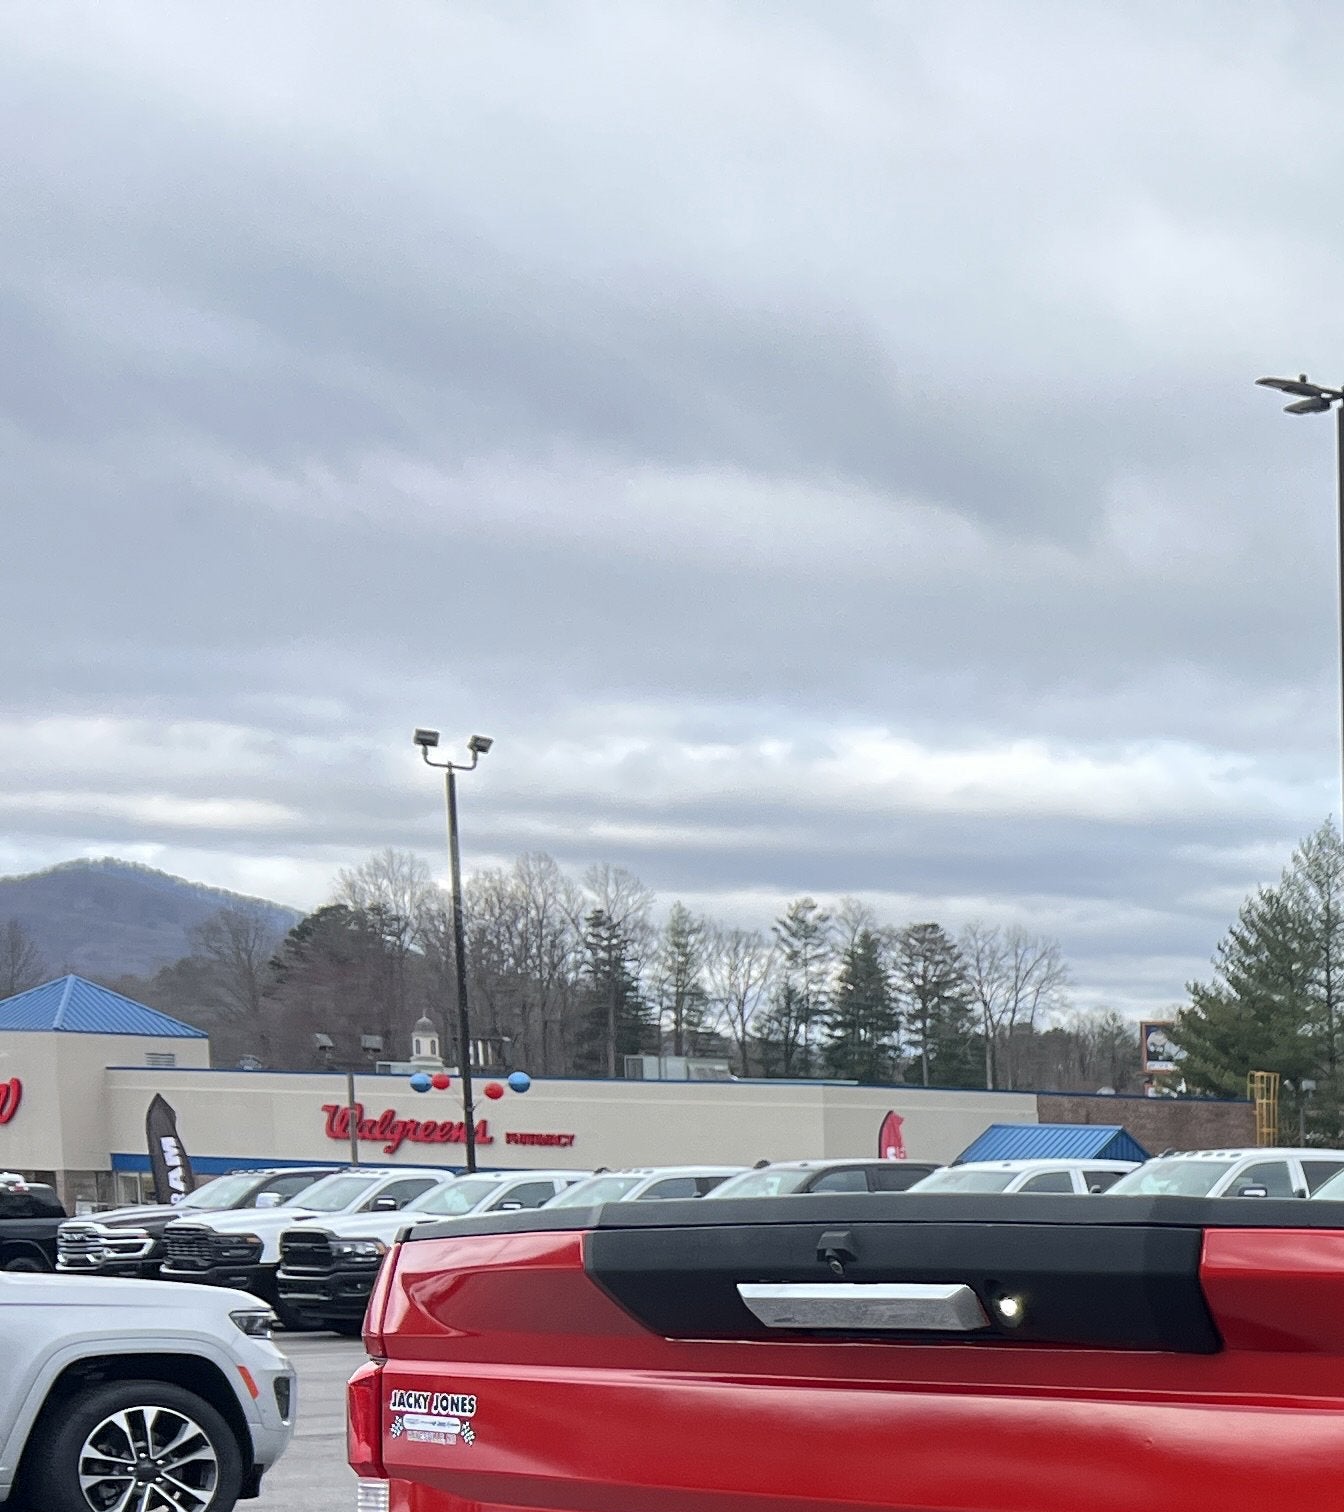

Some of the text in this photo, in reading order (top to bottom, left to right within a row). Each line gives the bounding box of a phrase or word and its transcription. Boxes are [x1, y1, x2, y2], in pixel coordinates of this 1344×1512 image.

[321, 1103, 494, 1155] Walgreens
[391, 1391, 476, 1414] JACKY JONES
